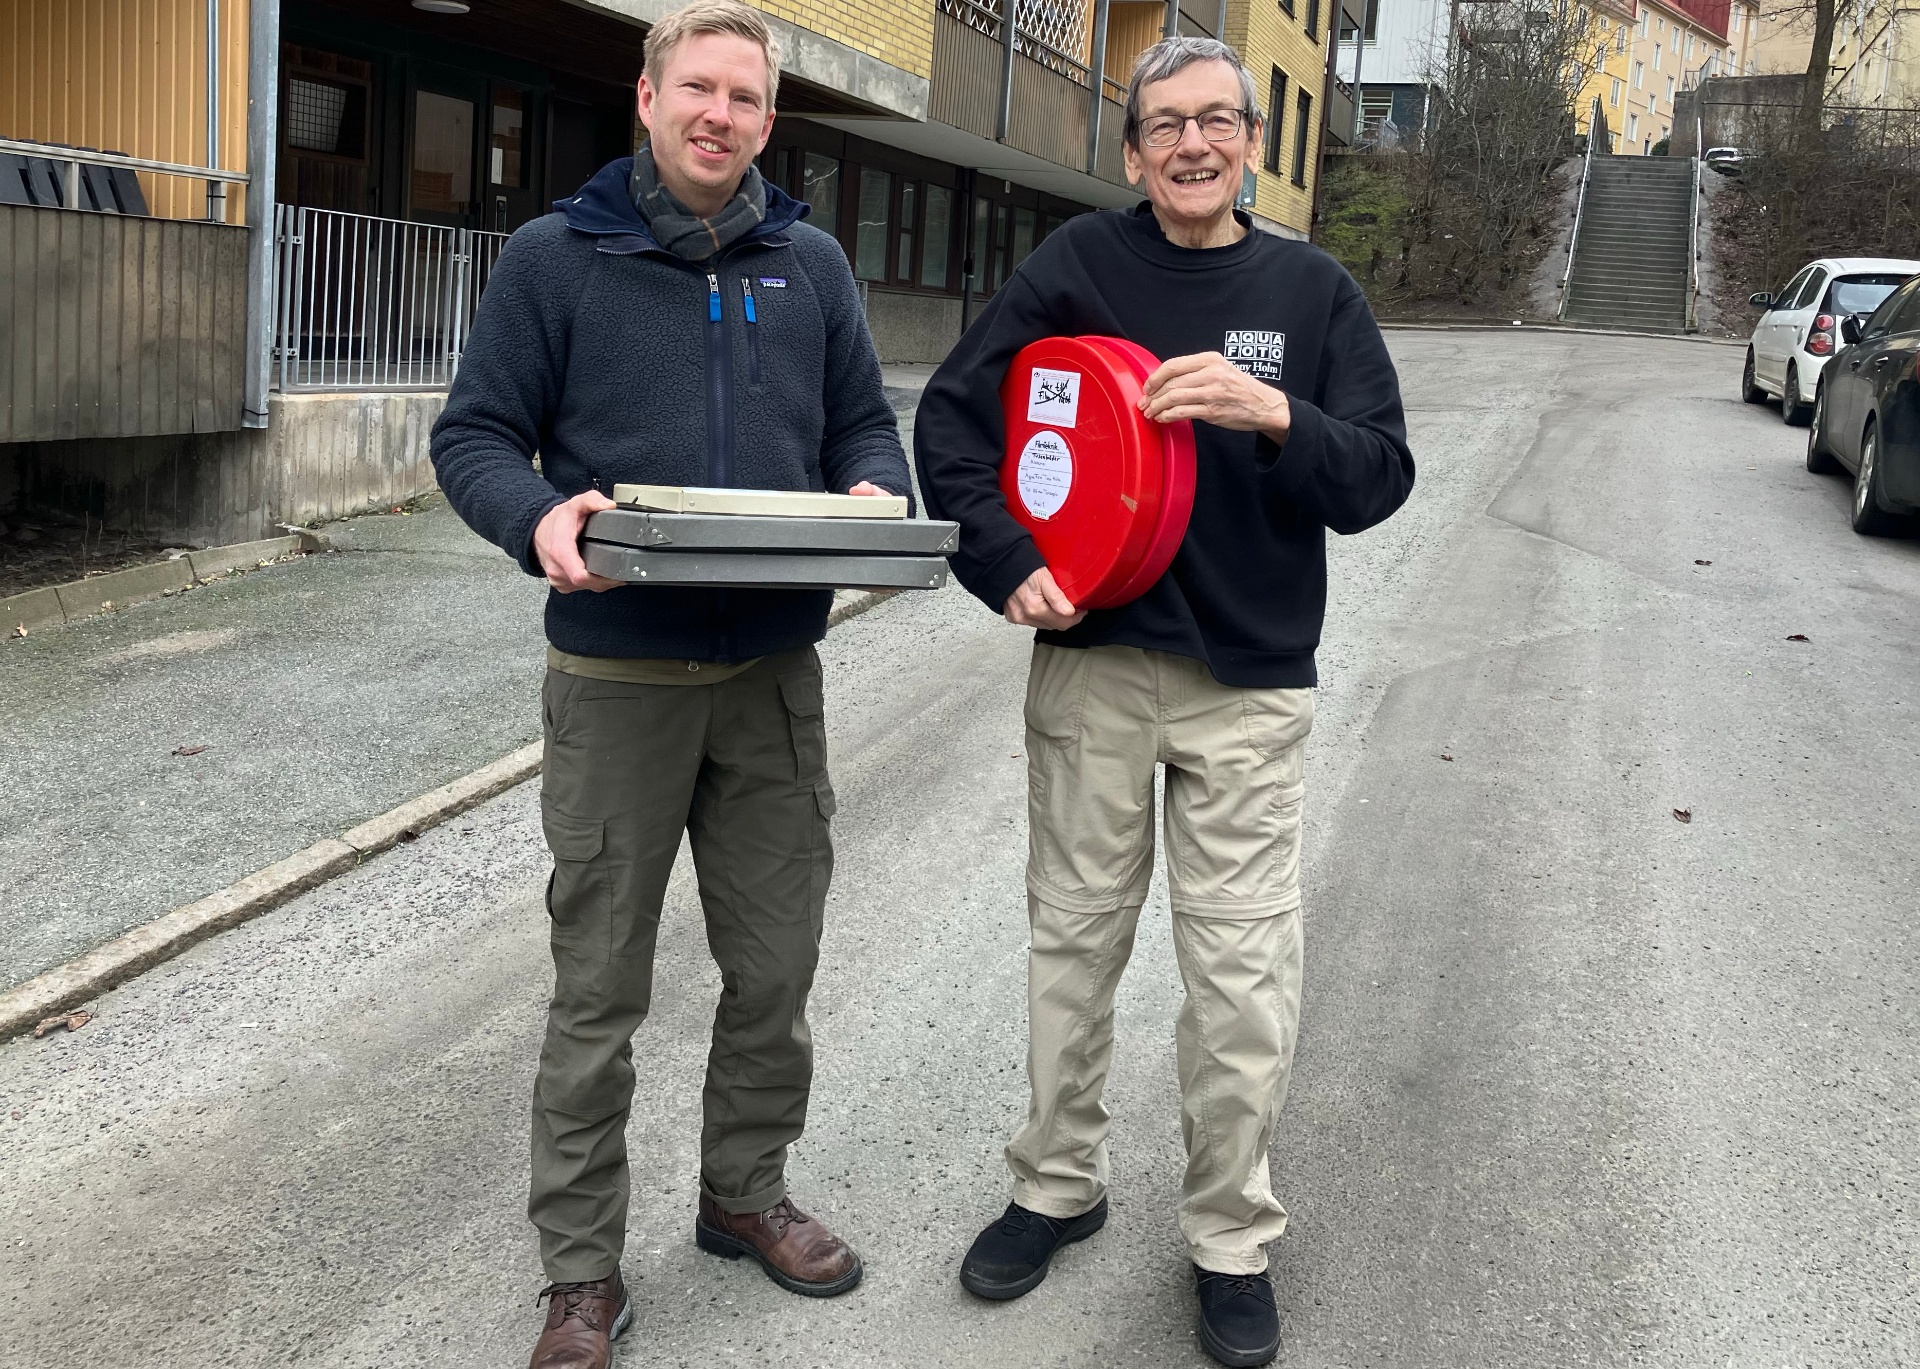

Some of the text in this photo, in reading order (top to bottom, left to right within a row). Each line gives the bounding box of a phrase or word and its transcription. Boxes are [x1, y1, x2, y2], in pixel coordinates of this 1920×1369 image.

[1227, 332, 1283, 346] AQUA
[1227, 346, 1282, 360] FOTO
[1252, 361, 1278, 374] Holm
